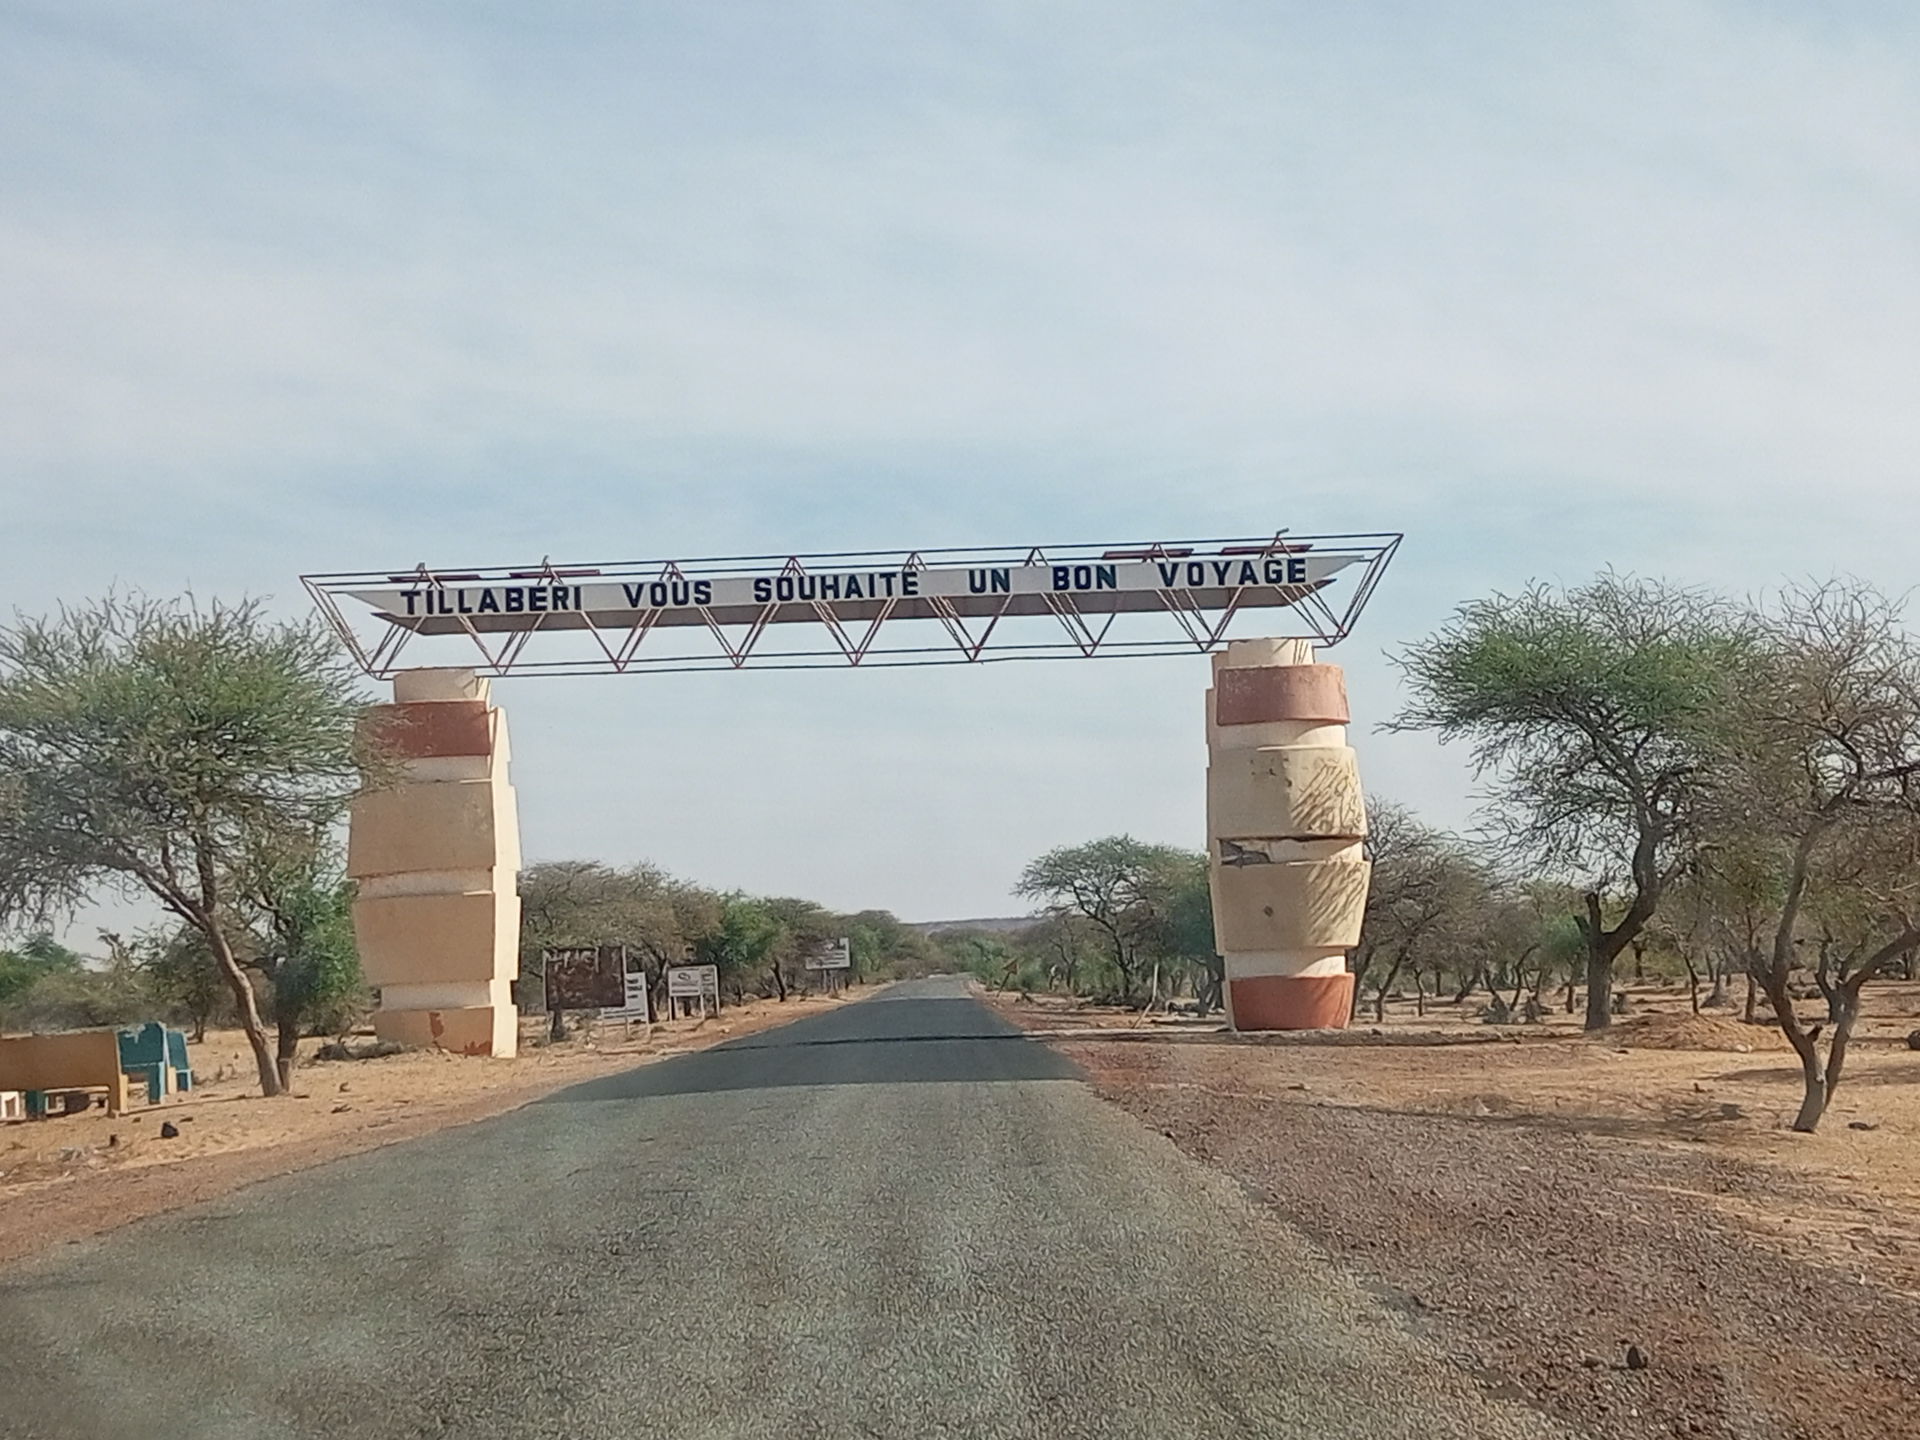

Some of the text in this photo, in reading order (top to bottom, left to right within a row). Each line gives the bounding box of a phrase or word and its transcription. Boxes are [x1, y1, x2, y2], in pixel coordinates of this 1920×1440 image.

[400, 558, 1306, 614] TILLABERI VOUS SOUHAITE UN BON VOYAGE
